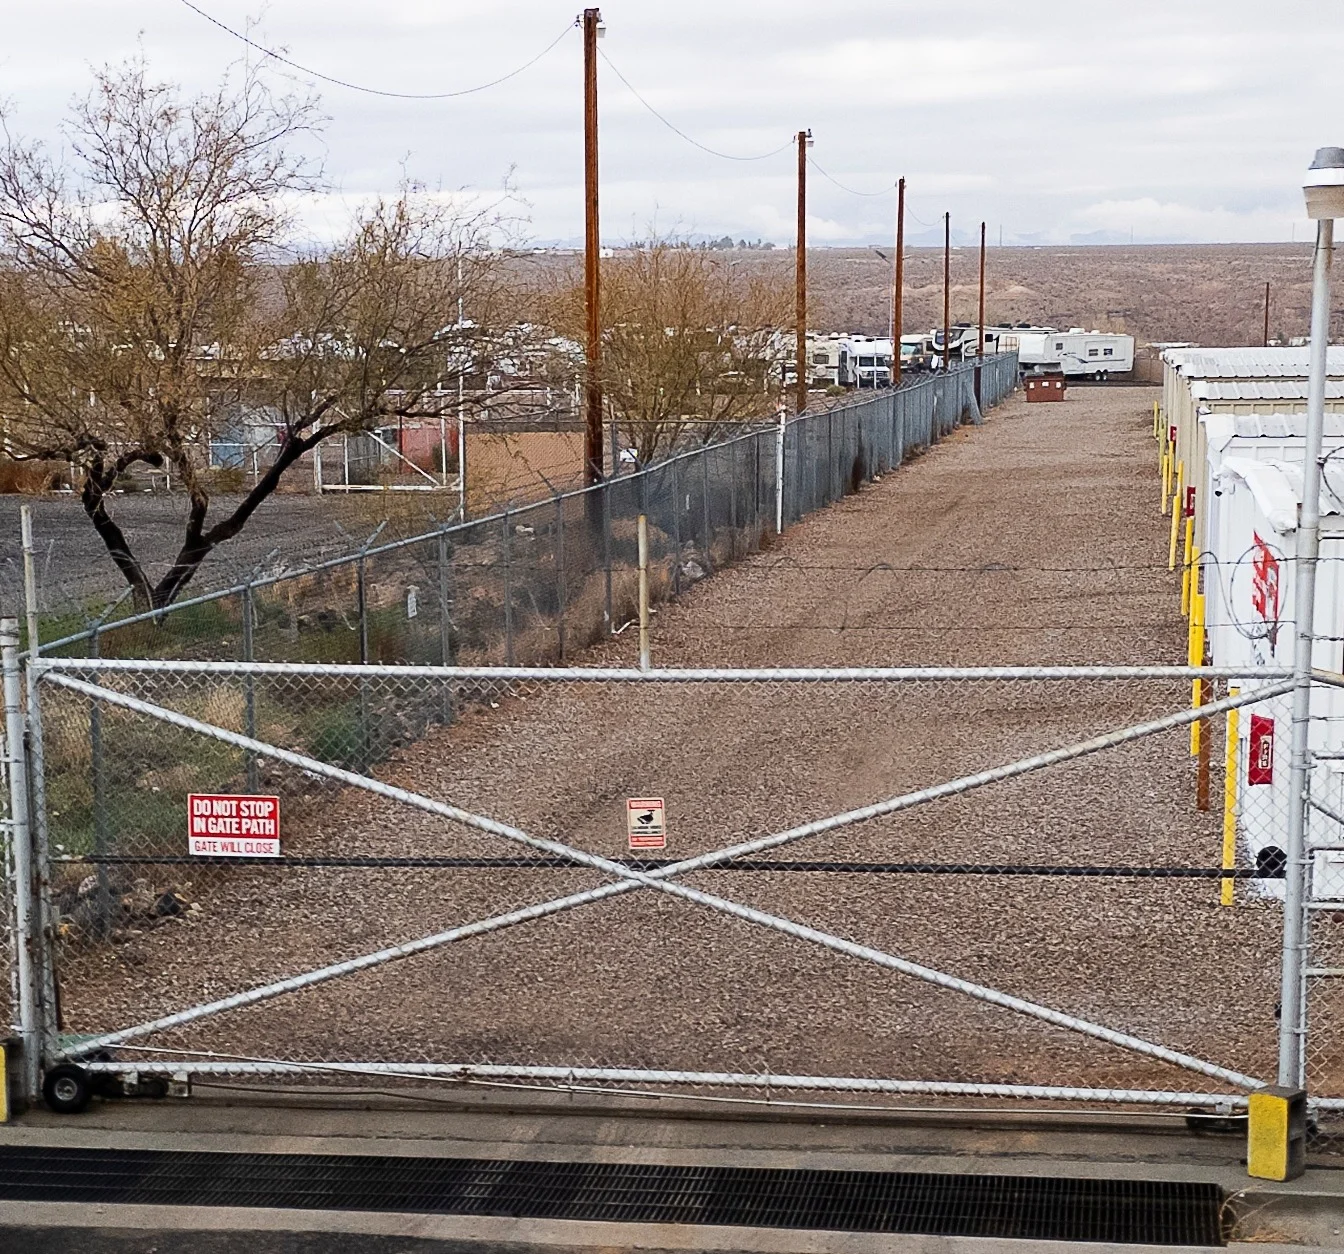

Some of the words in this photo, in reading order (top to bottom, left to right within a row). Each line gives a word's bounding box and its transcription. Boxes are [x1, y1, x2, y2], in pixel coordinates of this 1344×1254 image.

[192, 799, 212, 816] DO
[212, 800, 238, 817] NOT
[239, 801, 275, 817] STOP
[193, 817, 207, 833] IN
[207, 817, 240, 834] GATE
[241, 819, 275, 835] PATH
[194, 840, 218, 853] GATE
[220, 842, 243, 853] WILL
[244, 842, 275, 854] CLOSE
